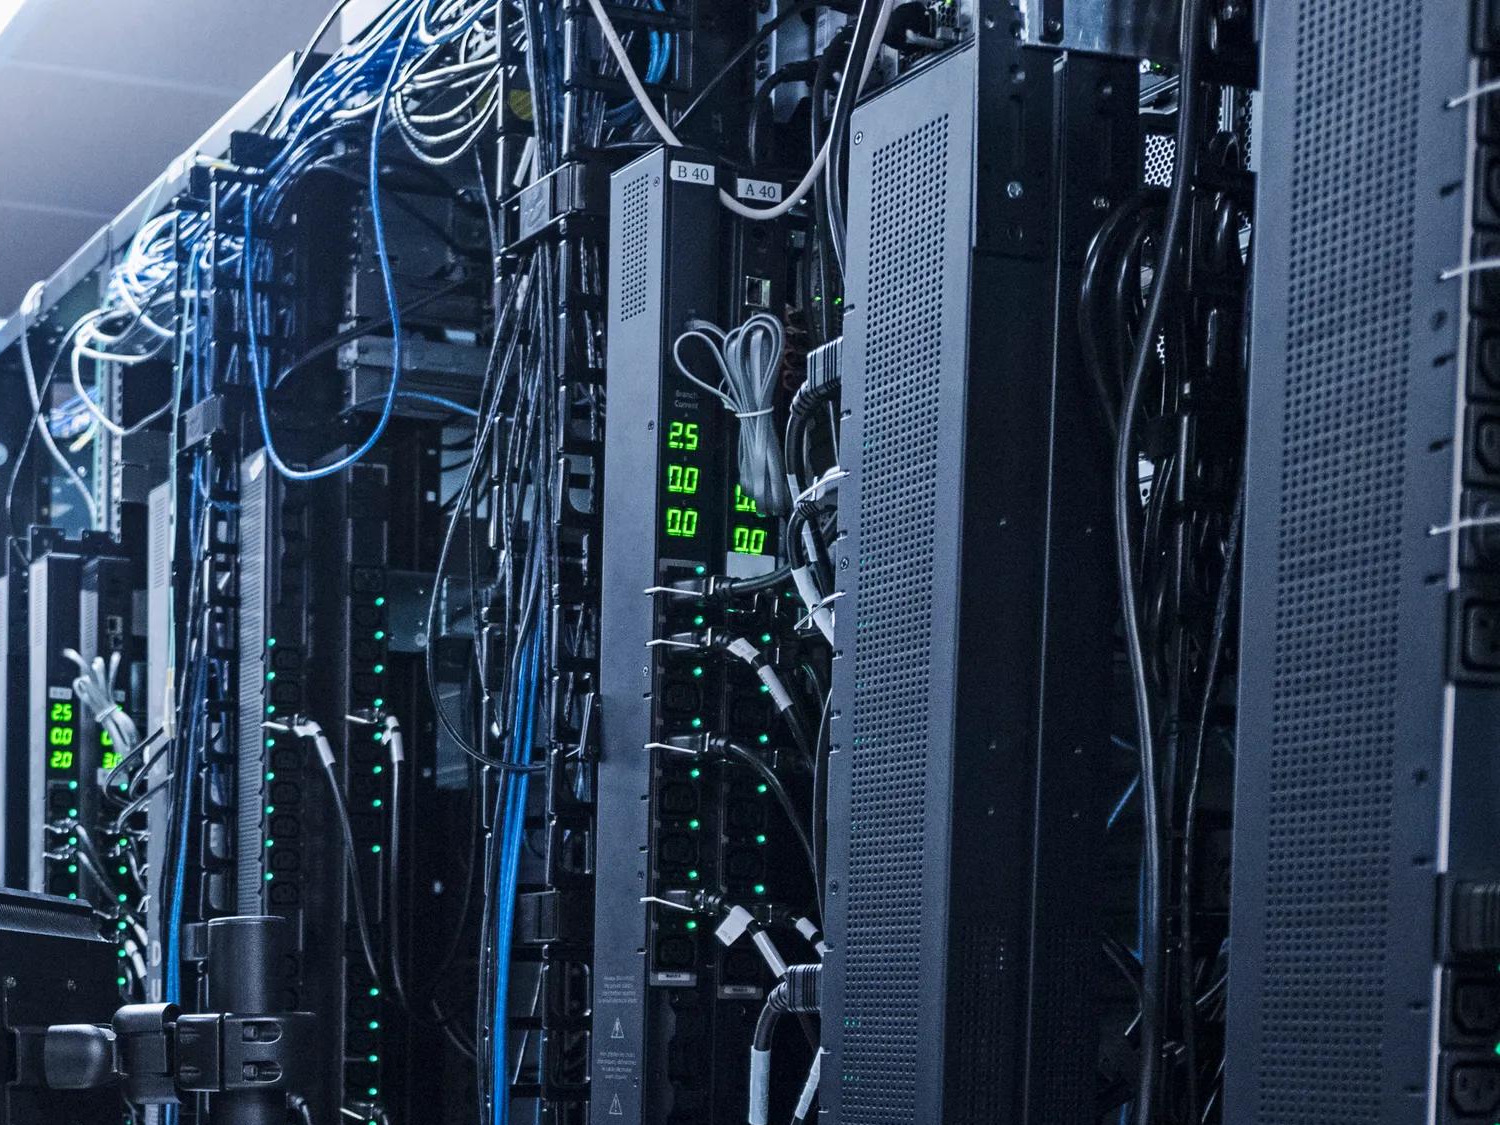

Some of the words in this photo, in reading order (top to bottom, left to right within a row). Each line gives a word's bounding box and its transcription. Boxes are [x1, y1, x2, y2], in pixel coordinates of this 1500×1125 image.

[677, 165, 688, 178] B
[692, 168, 709, 181] 40
[745, 183, 755, 196] A
[759, 186, 776, 199] 40
